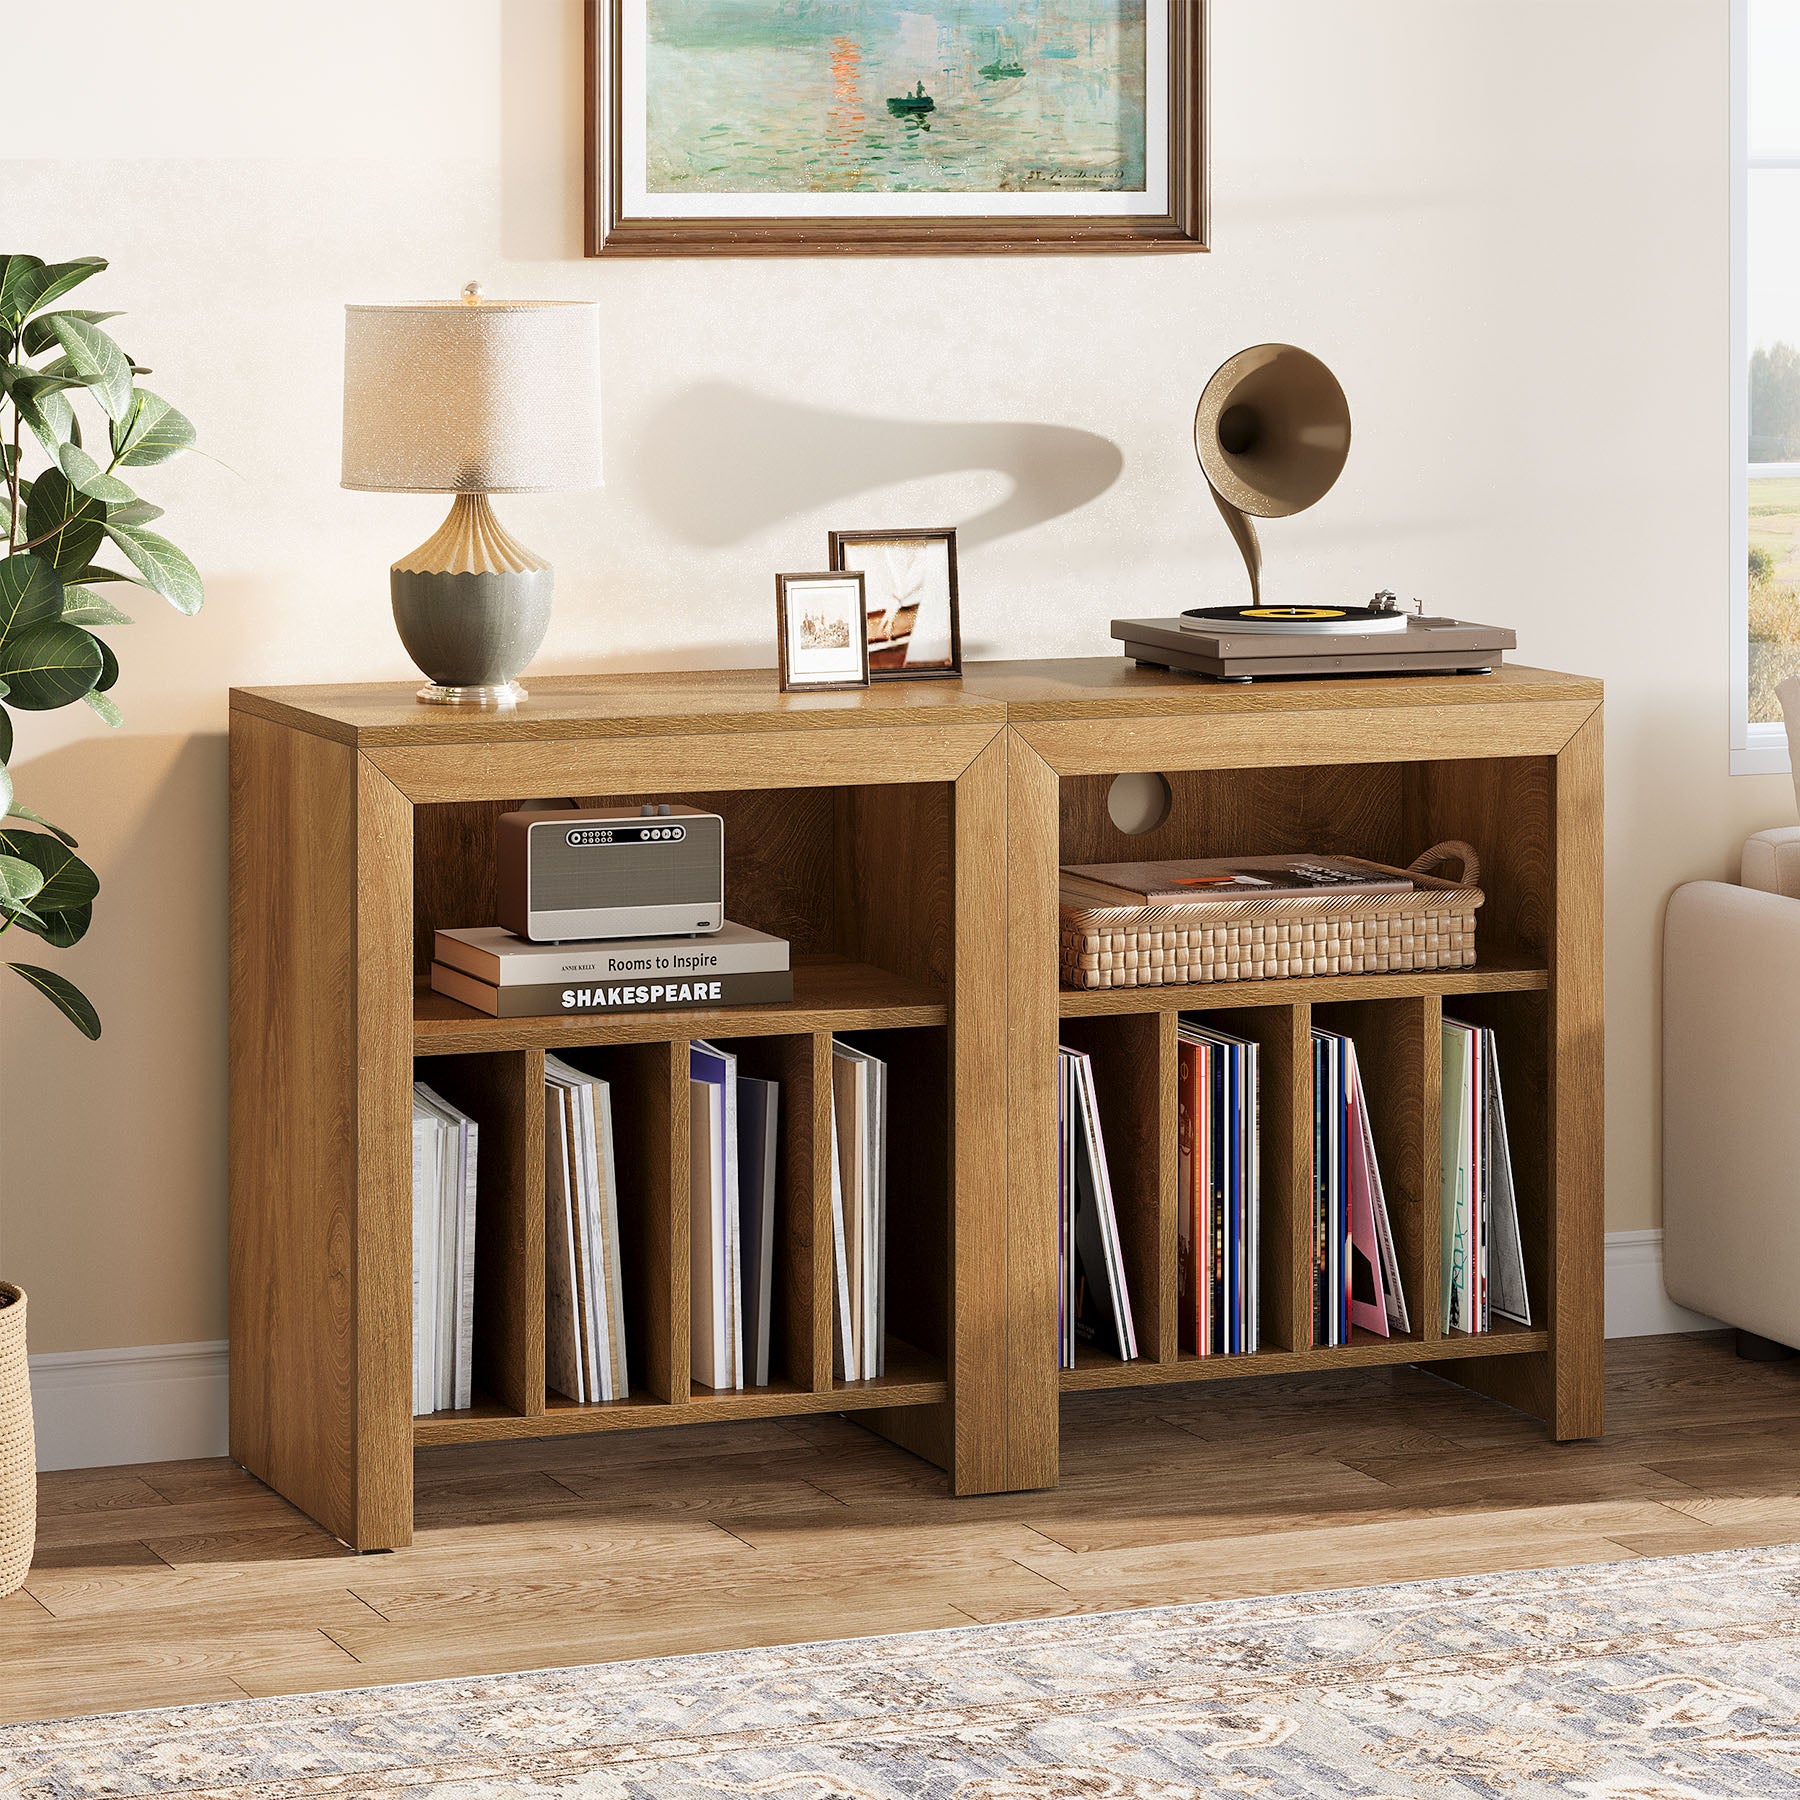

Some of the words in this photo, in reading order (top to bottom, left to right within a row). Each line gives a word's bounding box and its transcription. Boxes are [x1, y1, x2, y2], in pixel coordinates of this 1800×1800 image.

[608, 958, 652, 971] Rooms
[656, 956, 669, 969] to
[673, 953, 717, 971] Inspire
[561, 981, 722, 1008] SHAKESPEARE
